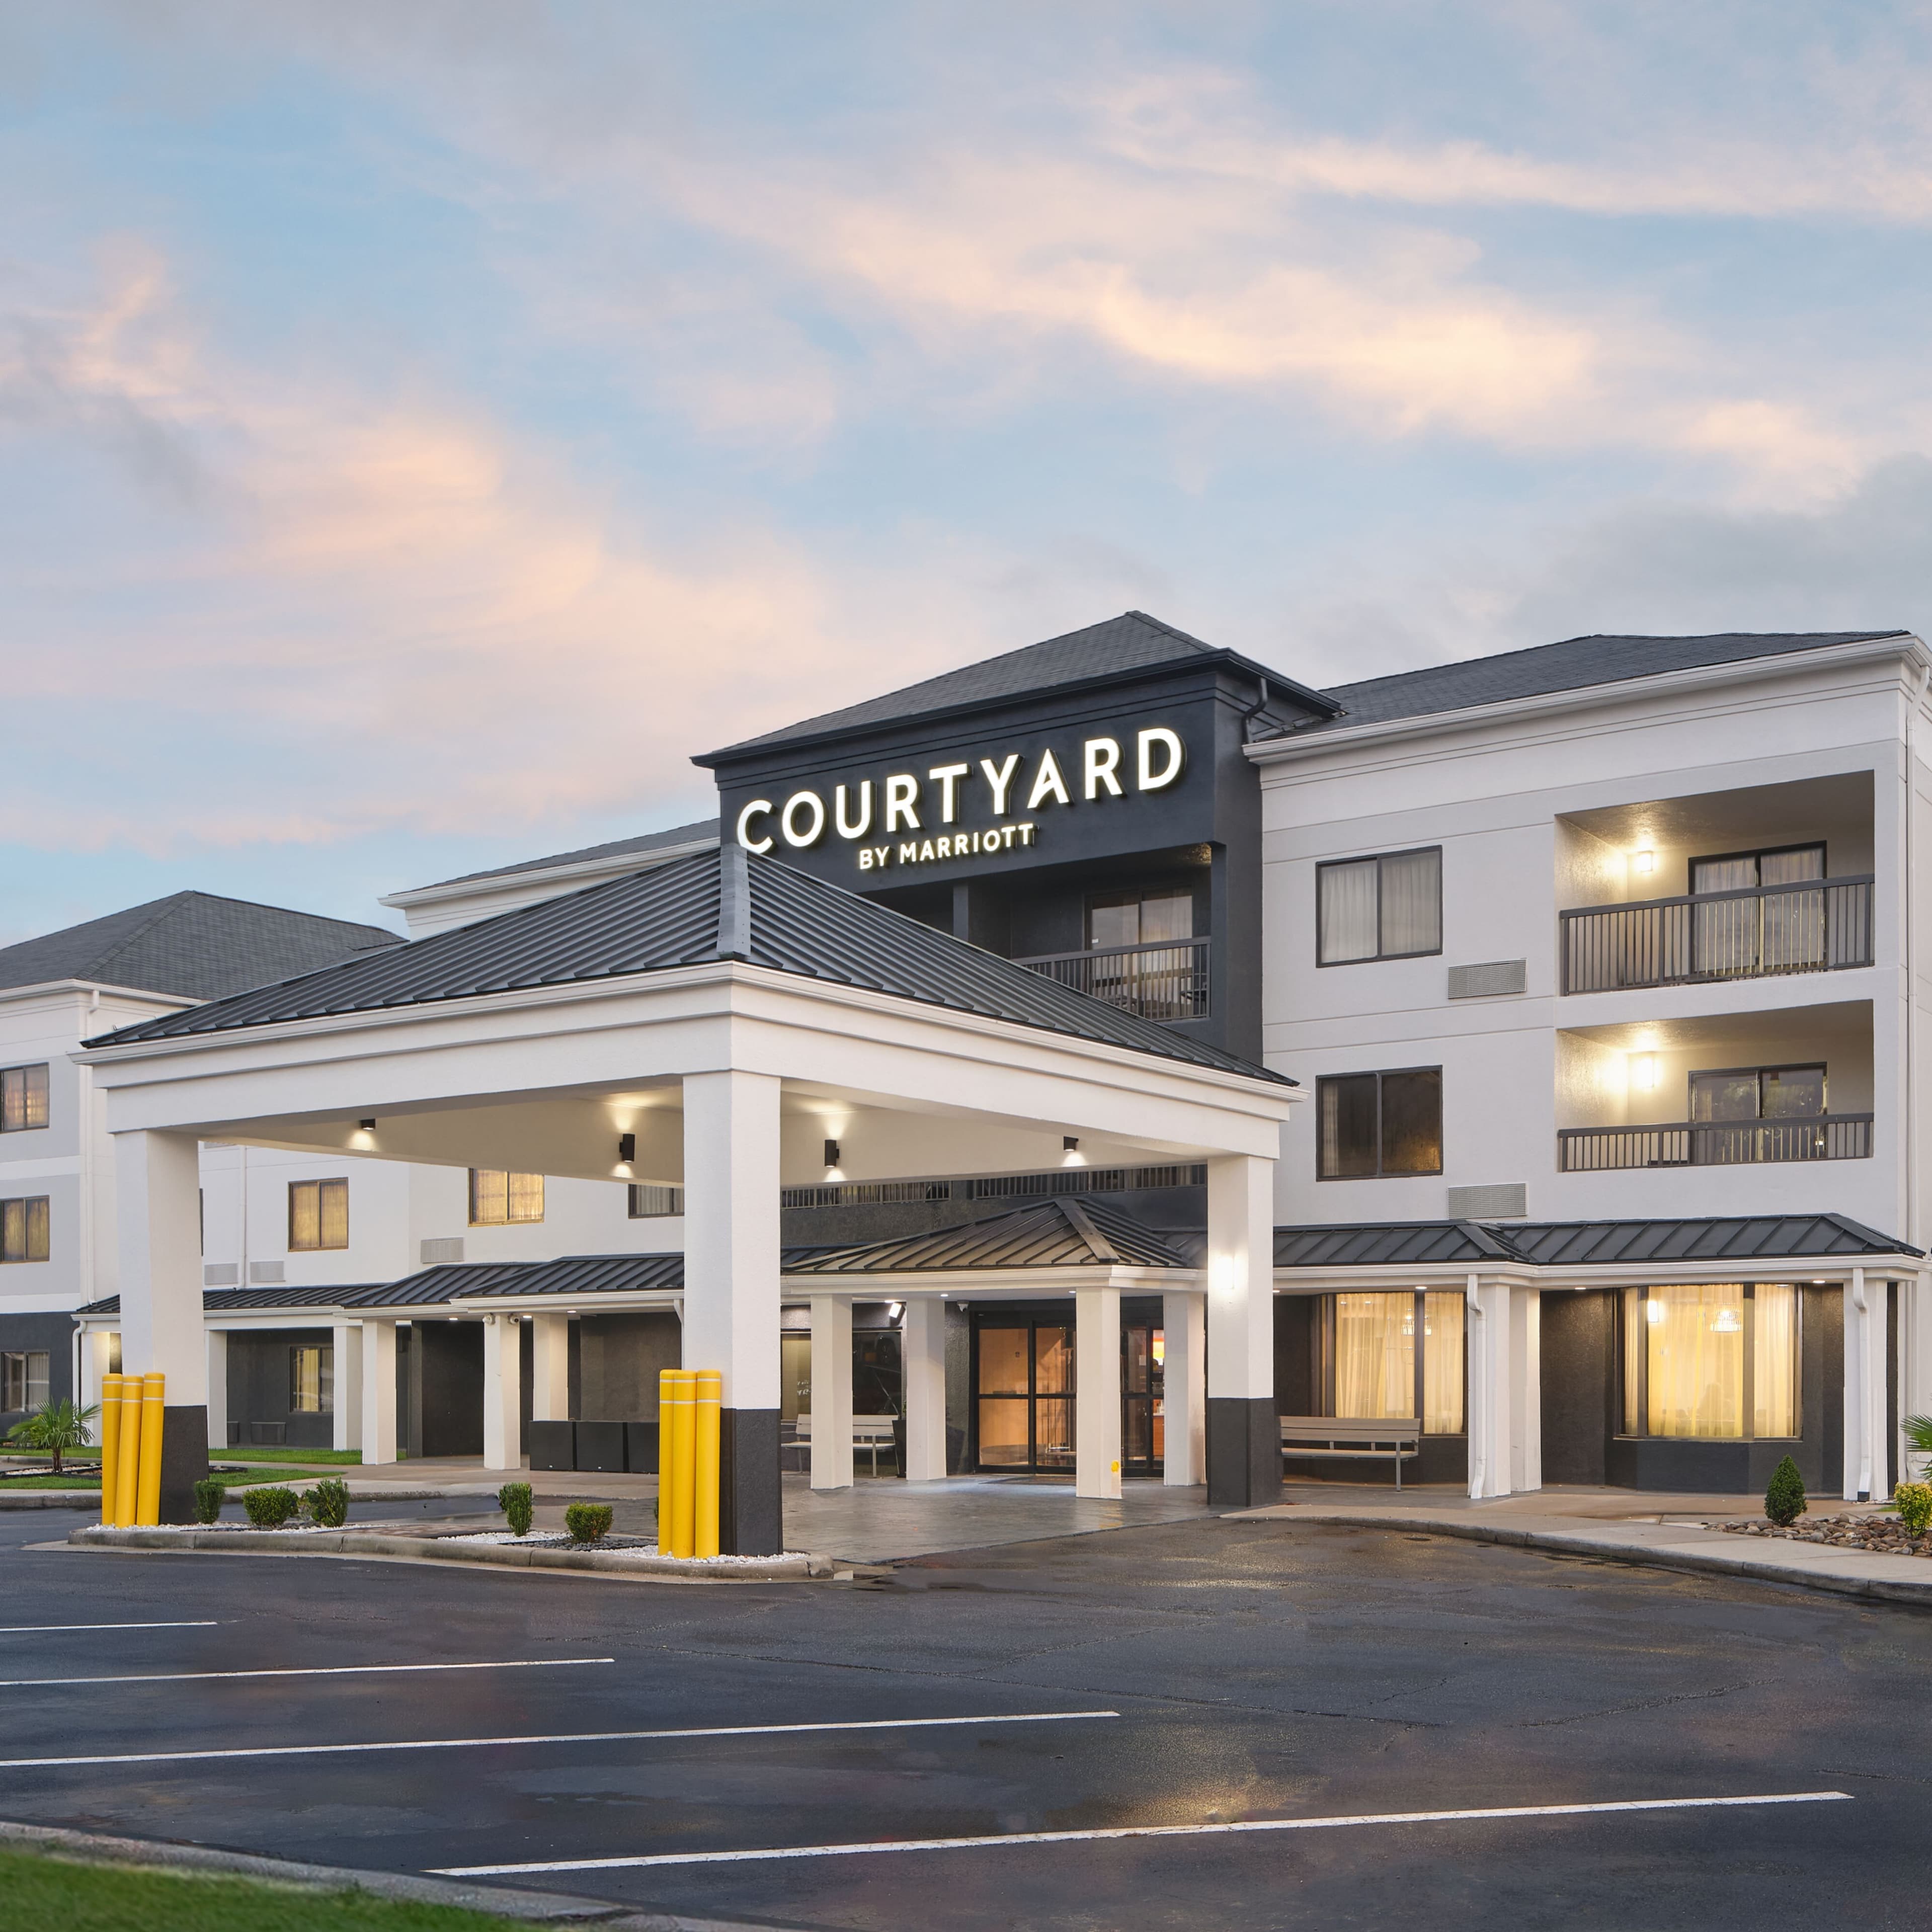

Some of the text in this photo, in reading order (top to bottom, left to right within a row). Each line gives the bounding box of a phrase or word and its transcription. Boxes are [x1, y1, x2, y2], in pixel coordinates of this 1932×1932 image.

[737, 727, 1183, 854] COURTYARD
[859, 823, 1034, 869] BY MARRIOTT
